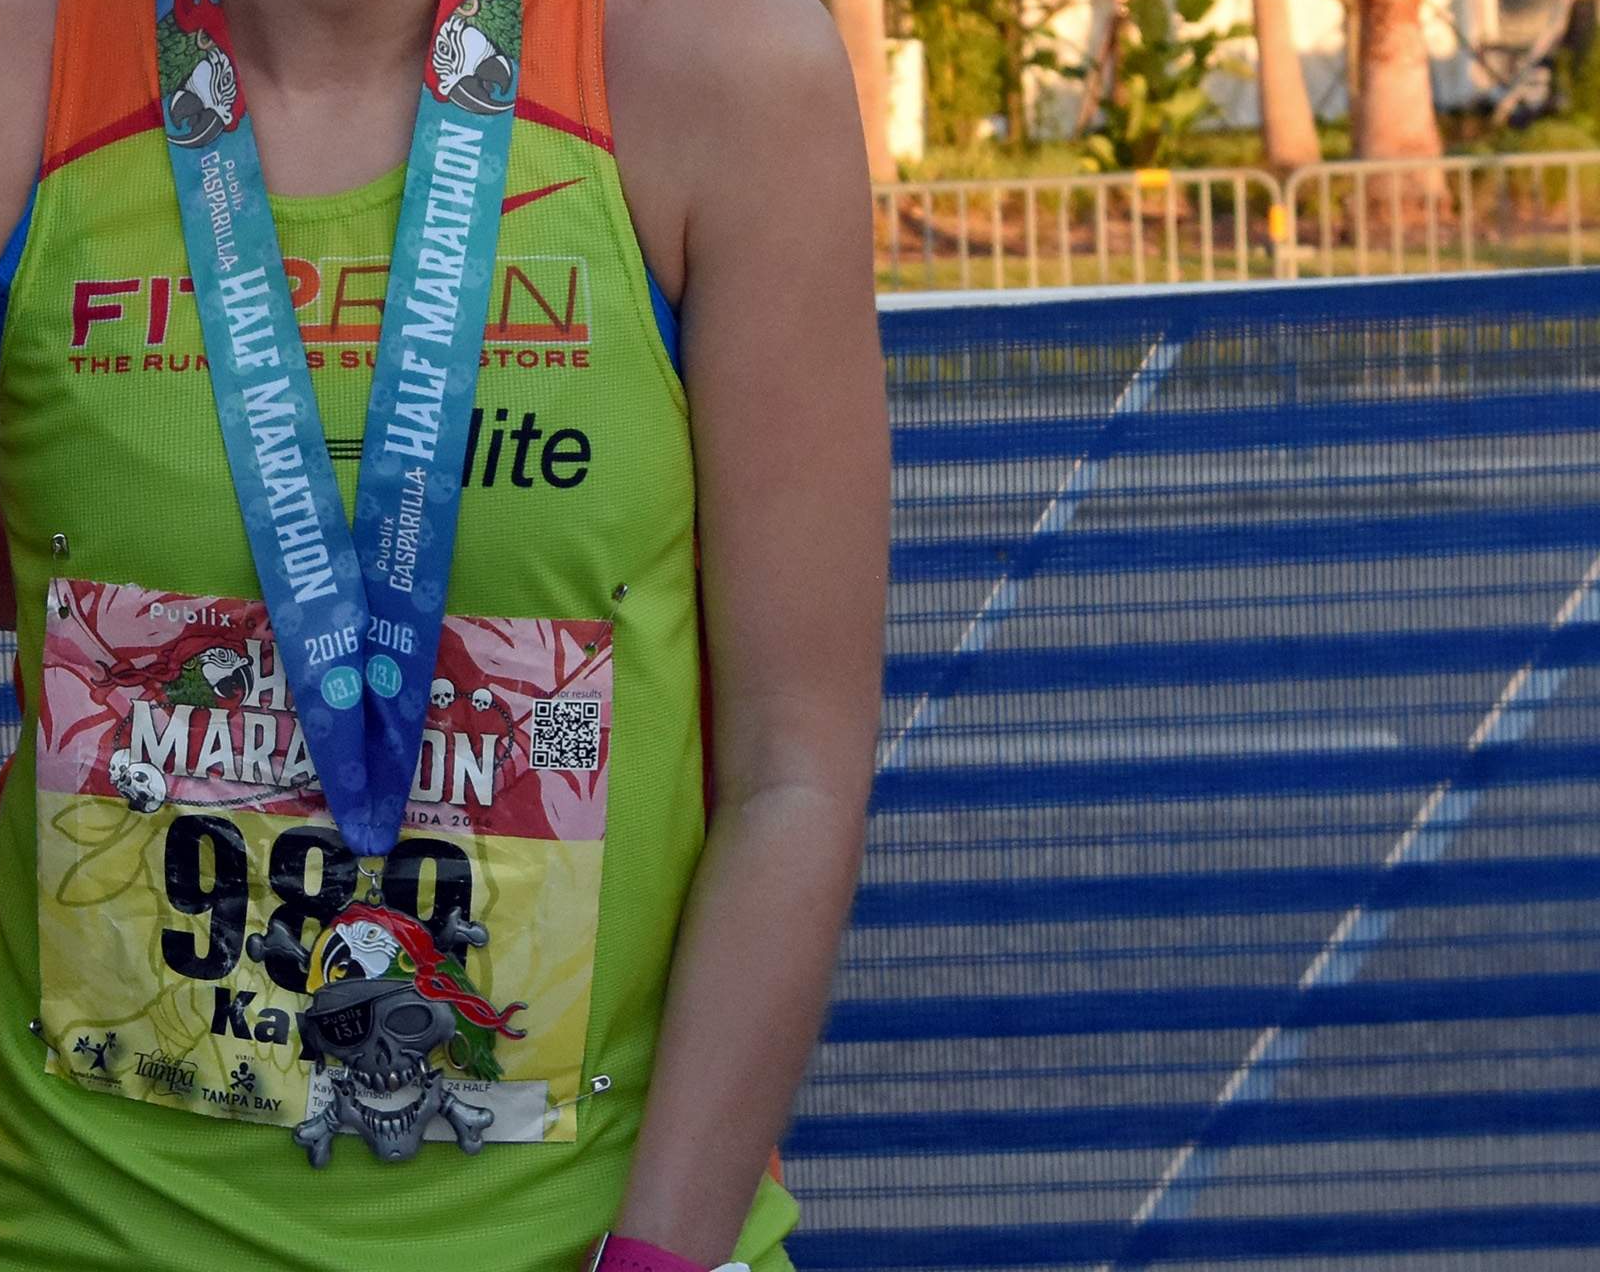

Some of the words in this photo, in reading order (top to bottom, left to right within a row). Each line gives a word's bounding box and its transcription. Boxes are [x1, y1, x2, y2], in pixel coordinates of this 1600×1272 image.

[201, 151, 239, 272] GASPARILLA
[400, 119, 484, 347] MARATHON
[218, 266, 281, 369] HALF
[69, 355, 131, 373] THE
[384, 350, 448, 461] HALF
[461, 408, 591, 489] lite
[242, 375, 338, 604] MARATHON
[389, 466, 427, 593] GASPARILLA
[305, 626, 359, 666] 2016
[366, 616, 414, 655] 2016
[327, 673, 360, 702] 13.1
[371, 663, 398, 692] 13.1
[572, 688, 602, 698] results
[129, 698, 499, 807] MARAON
[134, 1052, 197, 1096] Tampa
[447, 1082, 459, 1091] 24
[463, 1083, 492, 1093] HALF
[201, 1088, 249, 1108] TAMPA
[254, 1097, 282, 1112] BAY
